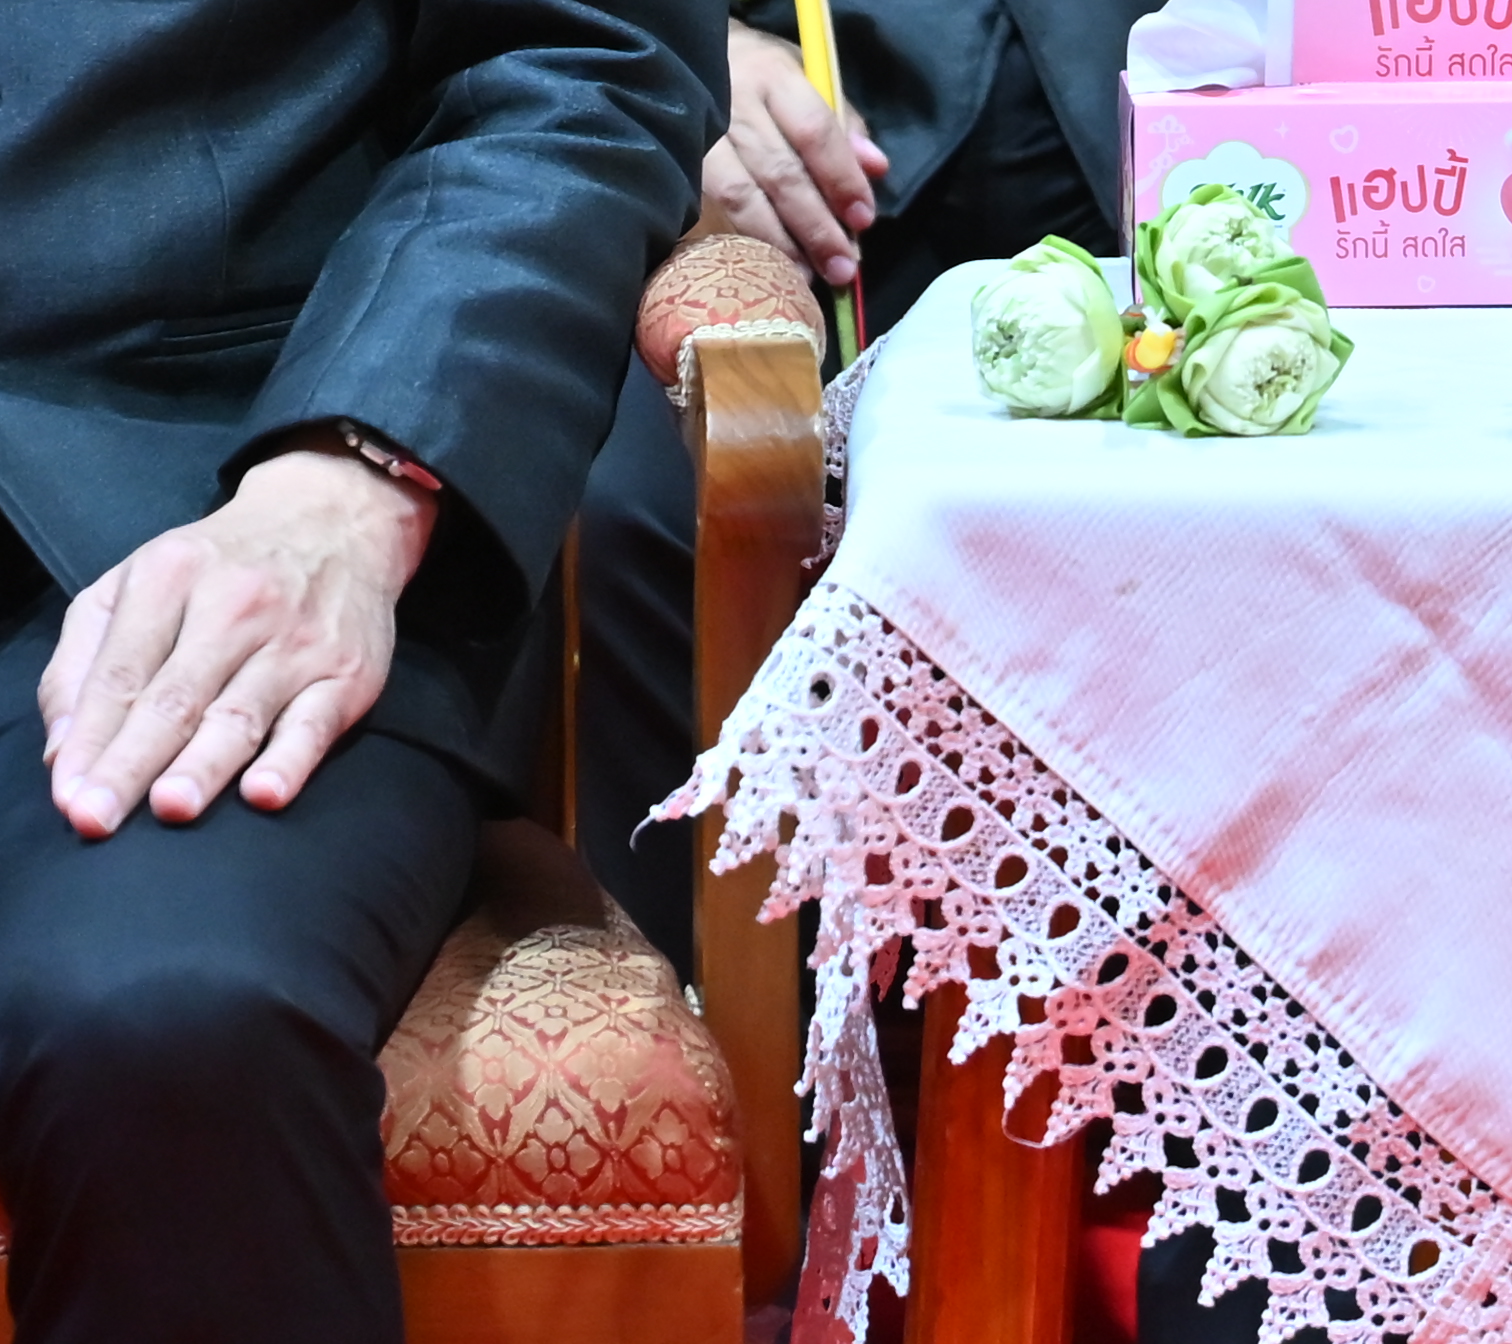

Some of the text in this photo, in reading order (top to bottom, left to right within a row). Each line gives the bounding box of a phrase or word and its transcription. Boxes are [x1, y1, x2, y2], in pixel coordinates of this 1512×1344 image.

[1375, 35, 1436, 78] รักนี้
[1329, 148, 1470, 224] แฮปปี้
[1335, 219, 1467, 260] รักนี้ สดใส
